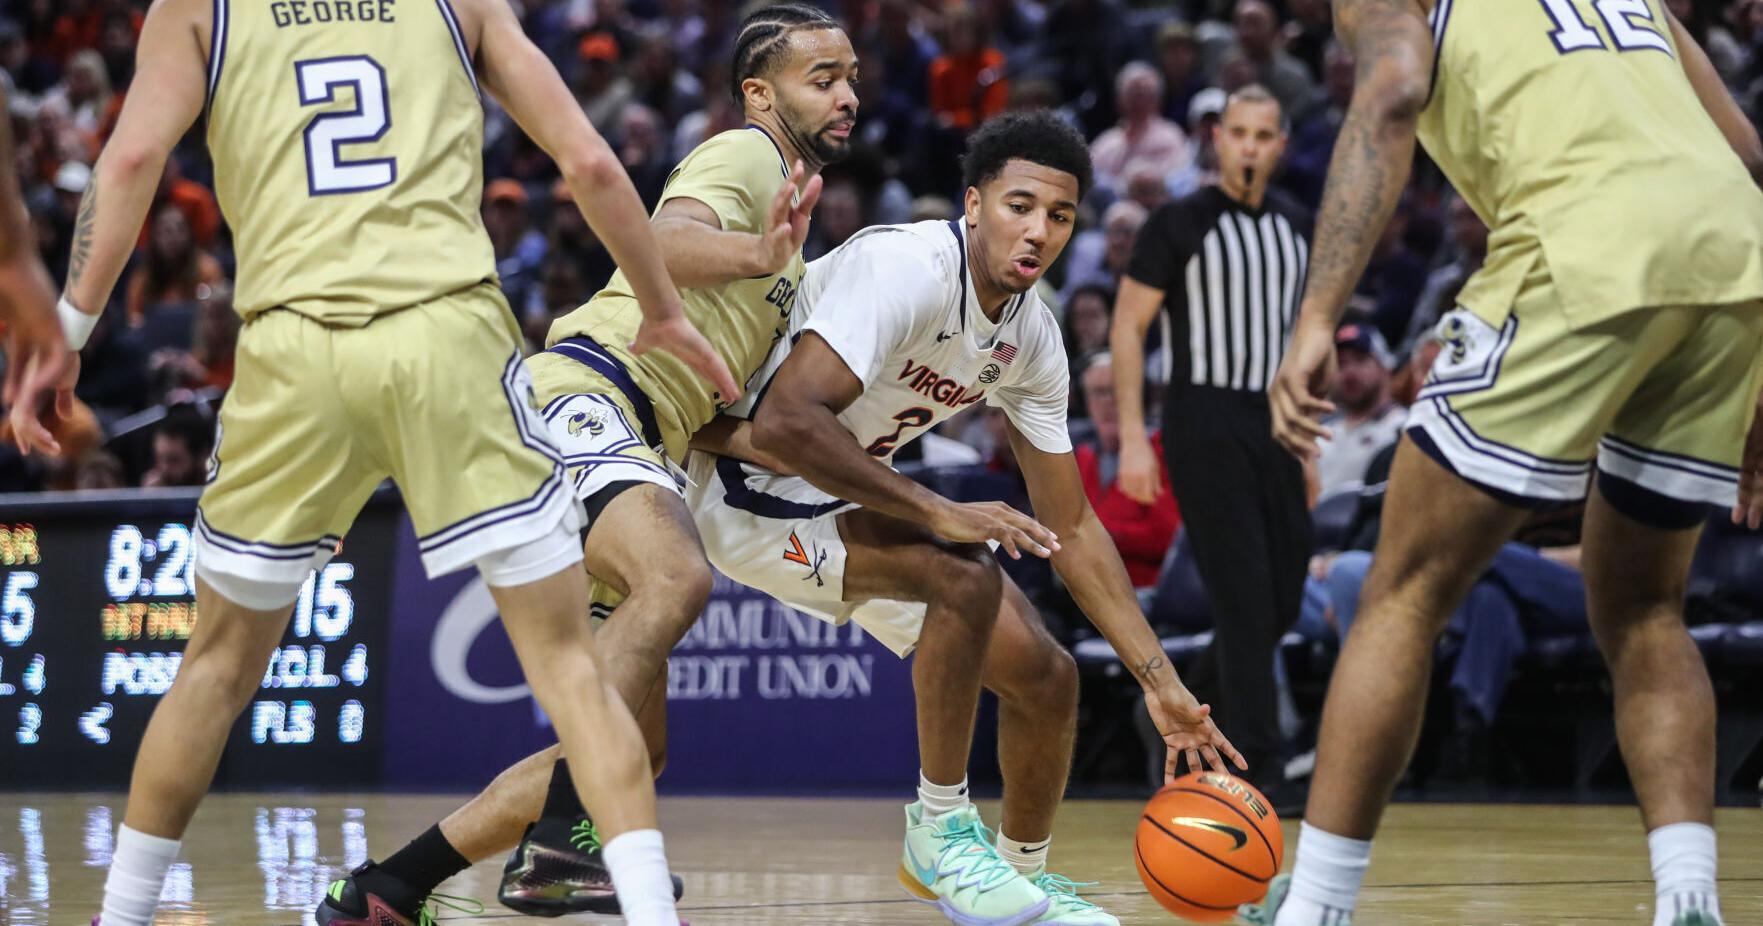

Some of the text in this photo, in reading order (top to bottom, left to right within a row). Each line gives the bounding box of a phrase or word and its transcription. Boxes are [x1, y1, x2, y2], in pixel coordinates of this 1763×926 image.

[271, 0, 396, 28] GEORGE
[294, 54, 397, 197] 2
[864, 406, 933, 458] 2
[294, 563, 355, 642] 15
[667, 654, 873, 699] EDIT UNION
